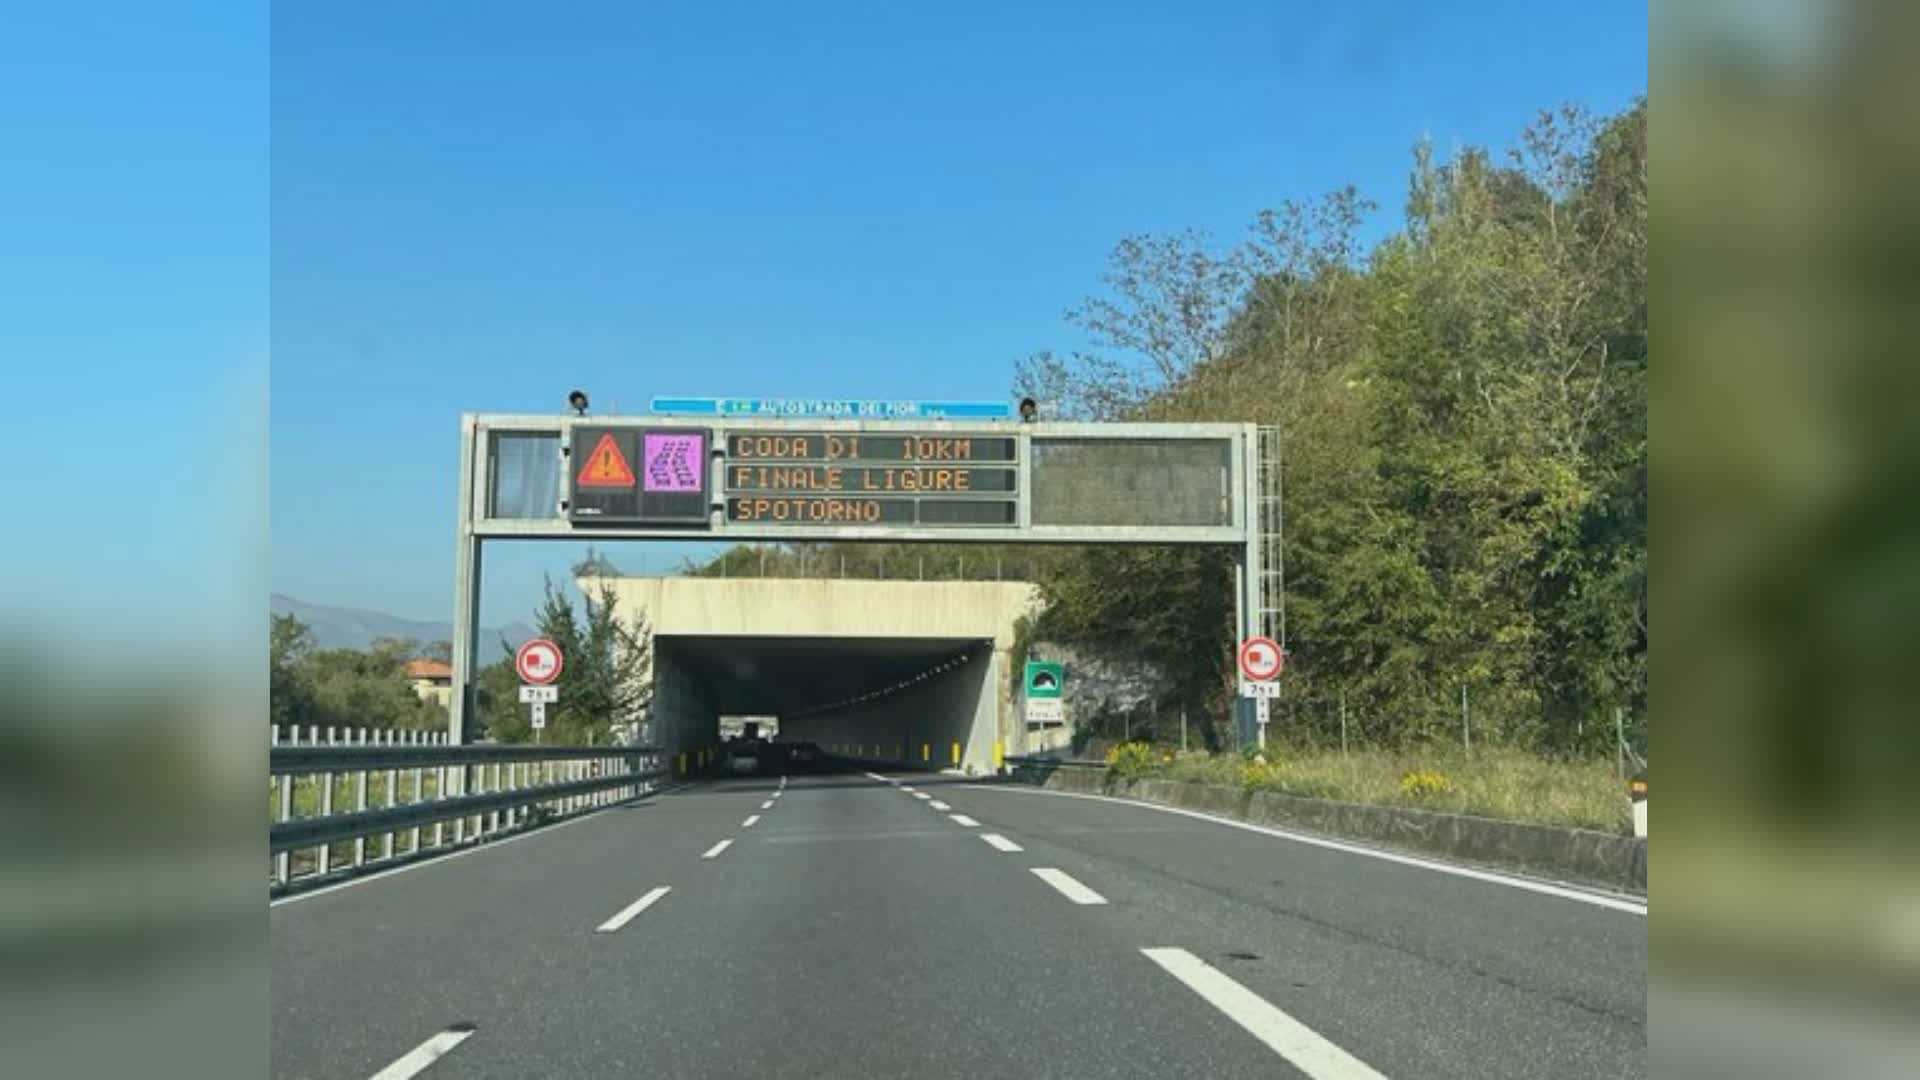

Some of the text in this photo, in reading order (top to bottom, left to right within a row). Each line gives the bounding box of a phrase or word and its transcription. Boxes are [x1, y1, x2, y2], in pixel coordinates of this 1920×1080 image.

[737, 437, 971, 460] CODA DI 10KM
[736, 467, 970, 490] FINALE LIGURE
[736, 499, 881, 520] SPOTORNO
